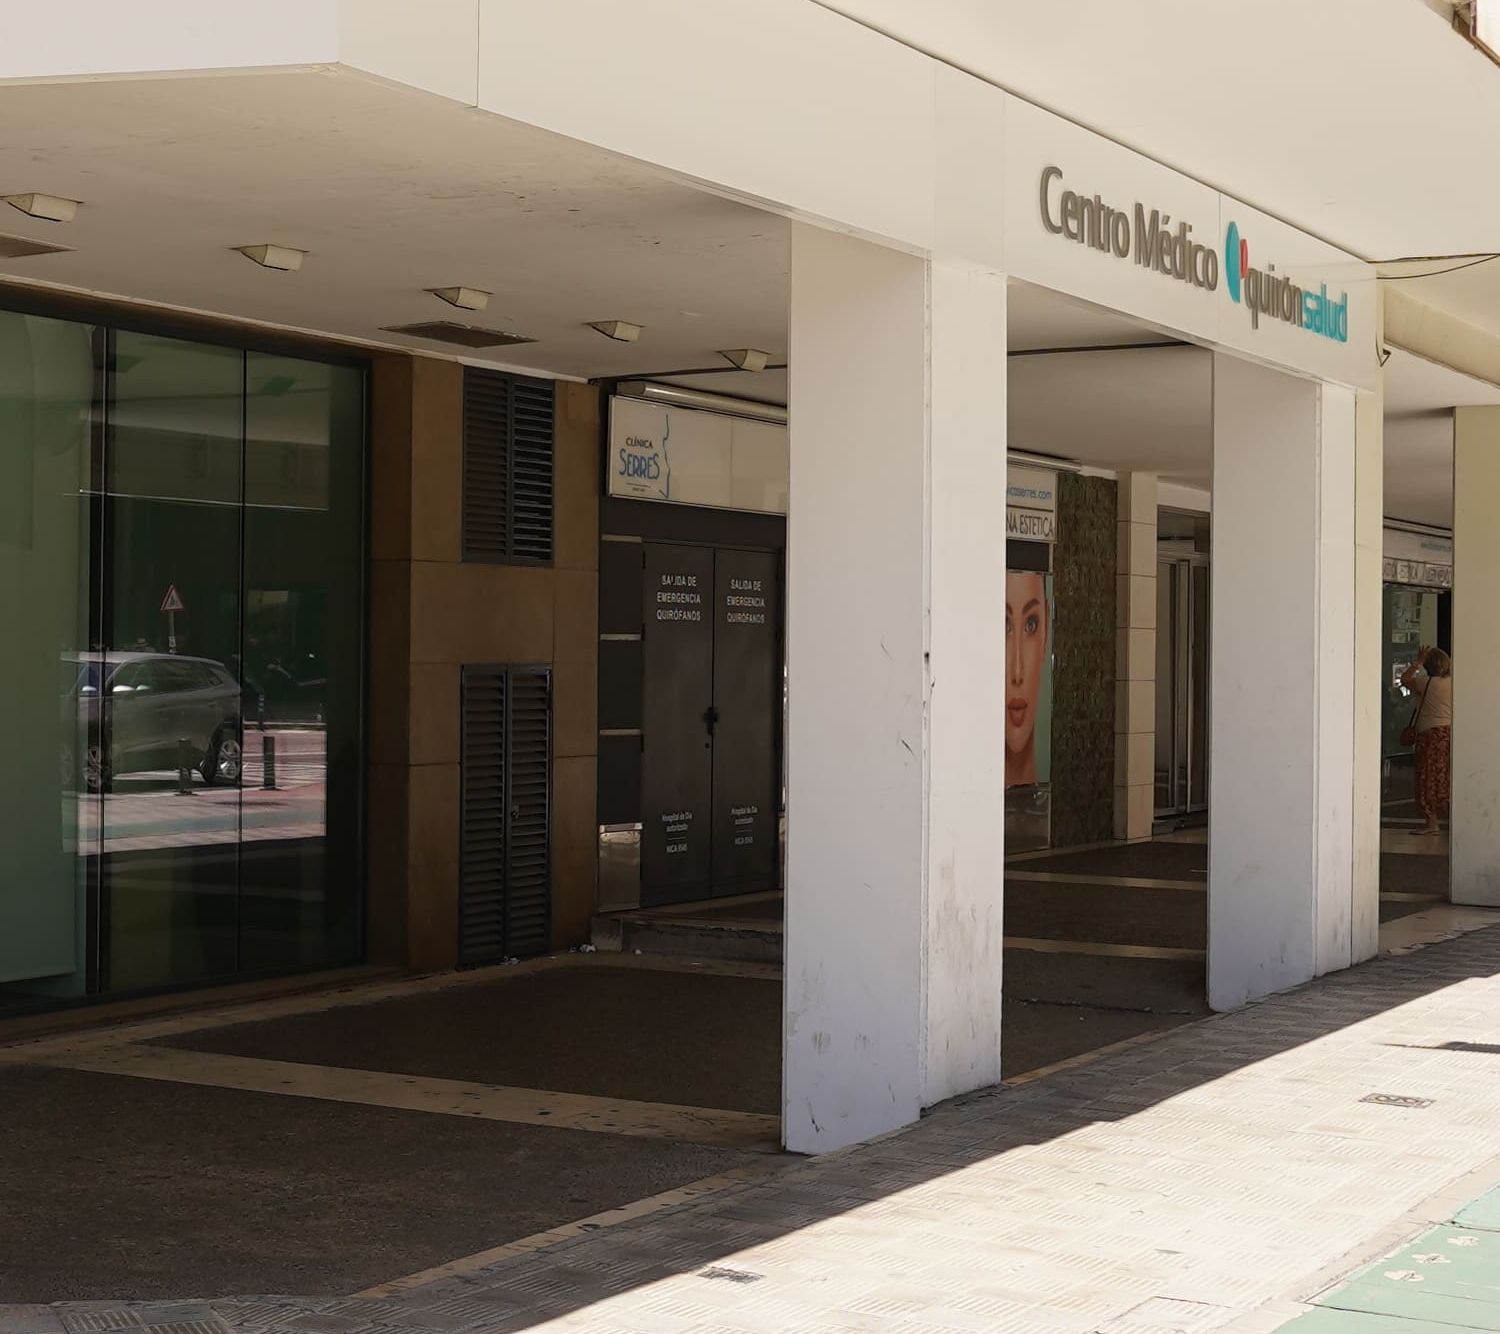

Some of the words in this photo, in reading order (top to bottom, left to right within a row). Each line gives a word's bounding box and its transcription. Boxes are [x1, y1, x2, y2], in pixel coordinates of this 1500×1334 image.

[1039, 166, 1131, 259] Centro
[1134, 202, 1218, 291] Médico
[1244, 260, 1348, 343] quirónsalud
[625, 436, 654, 450] CLÍNICA
[619, 448, 661, 480] SERRES
[687, 576, 697, 587] DE
[730, 579, 753, 590] SALIDA
[753, 581, 762, 591] DE
[656, 592, 701, 604] EMERGENCIA
[727, 595, 765, 607] EMERGENCIA
[656, 608, 701, 622] QUIRÓFANOS
